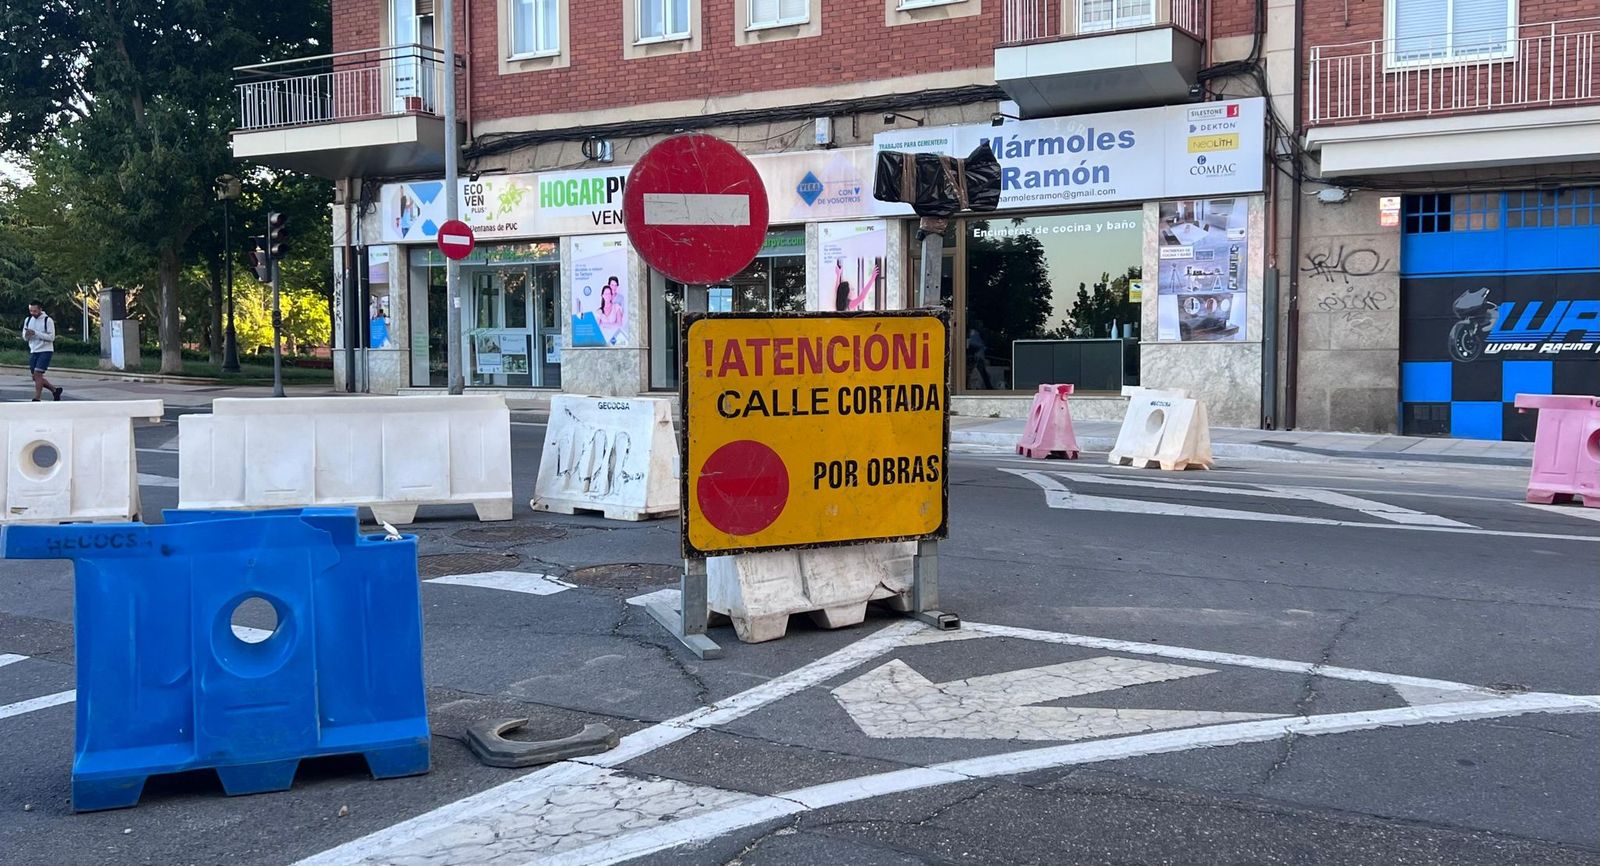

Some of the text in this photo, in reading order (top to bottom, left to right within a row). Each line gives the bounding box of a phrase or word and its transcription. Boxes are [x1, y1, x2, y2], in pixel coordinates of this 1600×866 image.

[1191, 108, 1222, 117] SILESTONE
[1201, 122, 1236, 131] DEKTON
[918, 138, 948, 147] CEMENTERIO
[1002, 160, 1111, 191] Ramón
[1190, 163, 1237, 176] COMPAC
[464, 183, 484, 195] ECO
[464, 195, 485, 207] VEN
[827, 196, 861, 204] VOSOTROS
[974, 219, 1137, 238] Encimeras de cocina y baño
[598, 401, 630, 410] GECOCSA
[717, 384, 941, 418] CALLE CORTADA
[813, 455, 940, 490] POR OBRAS
